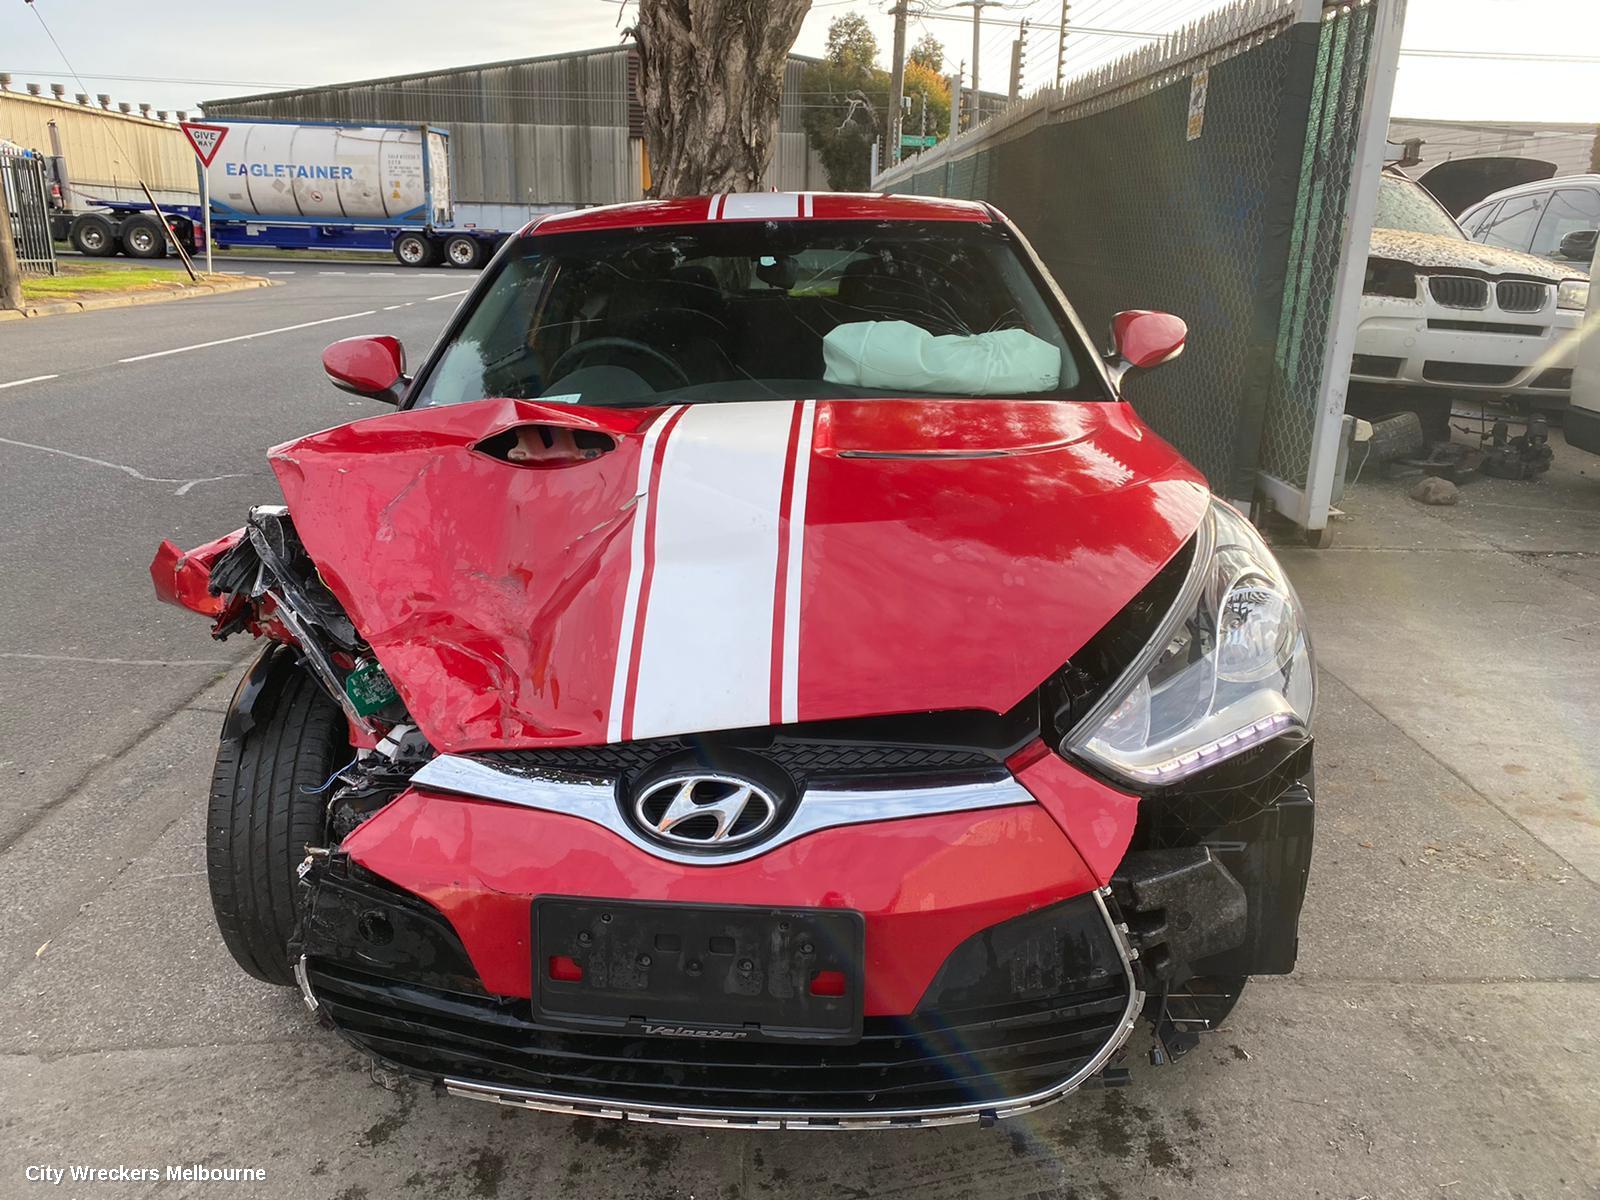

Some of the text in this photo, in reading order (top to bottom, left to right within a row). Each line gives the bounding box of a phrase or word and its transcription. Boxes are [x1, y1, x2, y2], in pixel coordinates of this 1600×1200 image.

[193, 131, 216, 140] GIVE
[226, 162, 354, 180] EAGLETAINER
[641, 1025, 747, 1039] Veloster
